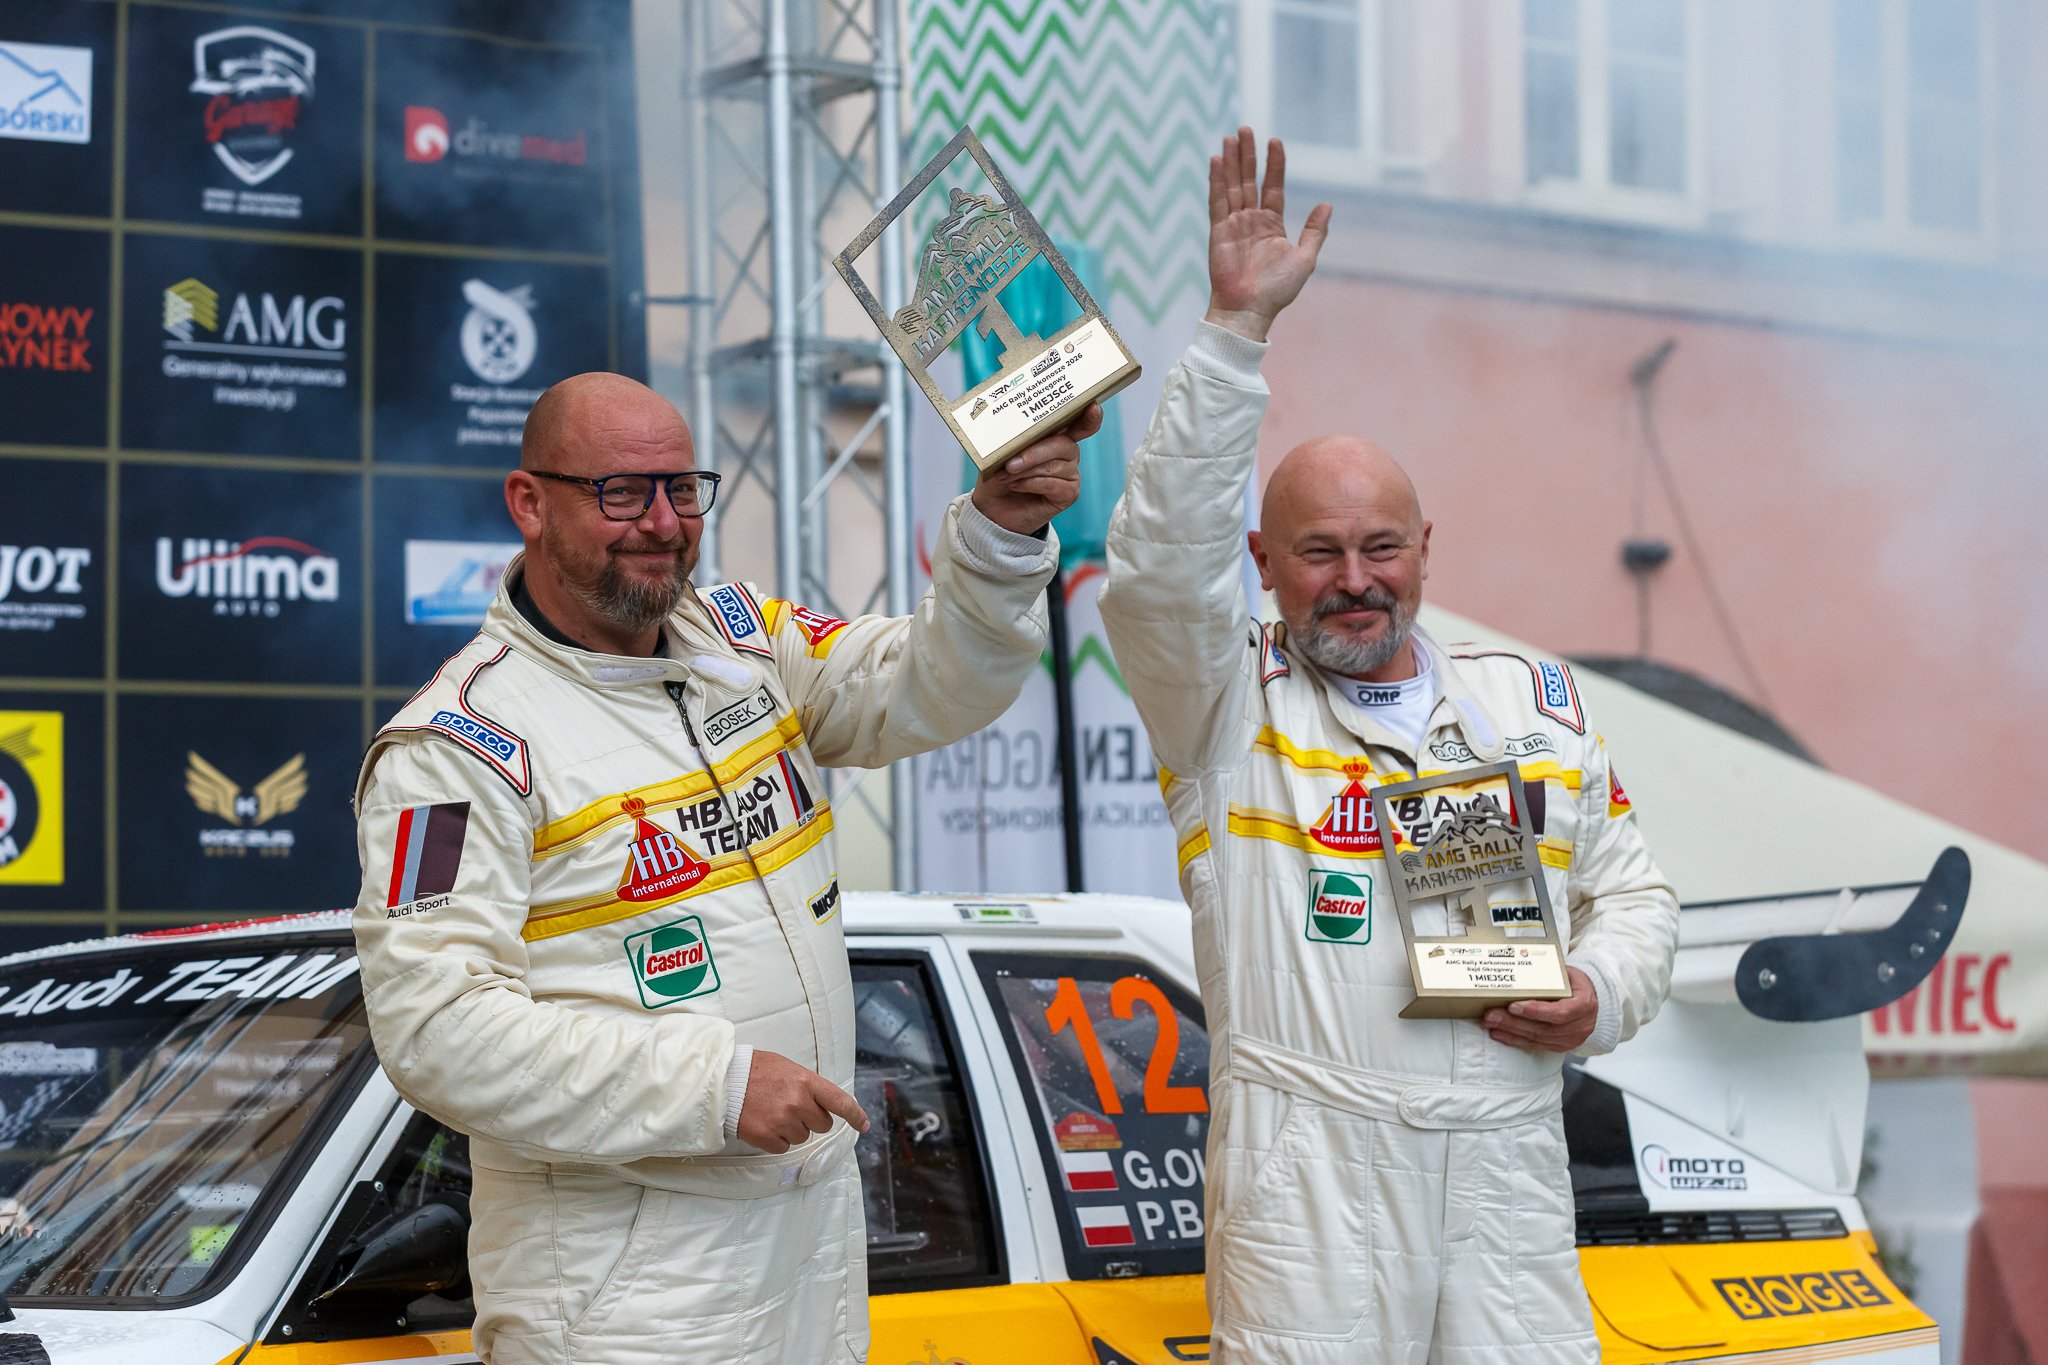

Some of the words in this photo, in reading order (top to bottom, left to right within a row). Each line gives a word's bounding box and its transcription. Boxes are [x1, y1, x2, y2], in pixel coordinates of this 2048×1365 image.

[961, 212, 1018, 275] RALLY
[912, 235, 1030, 358] KARKONOSZE
[224, 292, 345, 349] AMG
[992, 403, 1008, 416] AMG
[1009, 390, 1025, 404] Rally
[1026, 365, 1066, 393] Karkonosze
[1065, 352, 1083, 367] 2026
[1016, 396, 1033, 409] Rajd
[1033, 375, 1067, 398] Okręgowy
[1022, 409, 1029, 418] 1
[1029, 381, 1074, 414] MIEJSCE
[1032, 410, 1049, 423] Klasa
[1049, 392, 1075, 412] CLASSIC
[213, 601, 280, 617] AUTO
[712, 588, 751, 635] sparco
[1358, 690, 1400, 702] OMP
[434, 712, 513, 757] sparco
[676, 796, 723, 832] HB
[700, 803, 779, 856] TEAM
[1332, 796, 1379, 832] HB
[628, 831, 685, 881] HB
[1321, 832, 1381, 845] internation
[1426, 847, 1466, 870] AMG
[1469, 835, 1524, 860] RALLY
[631, 867, 701, 898] international
[1404, 856, 1525, 893] KARKONOSZE
[387, 904, 412, 919] Audi
[415, 895, 450, 913] Sport
[1316, 895, 1366, 916] Castrol
[646, 943, 703, 975] Castrol
[135, 954, 360, 1004] TEAM
[1475, 974, 1516, 982] MIEJSCE
[1045, 976, 1210, 1115] 12
[1670, 1158, 1744, 1174] MOTO
[1137, 1199, 1205, 1241] P.B
[1721, 1273, 1883, 1317] BOGE
